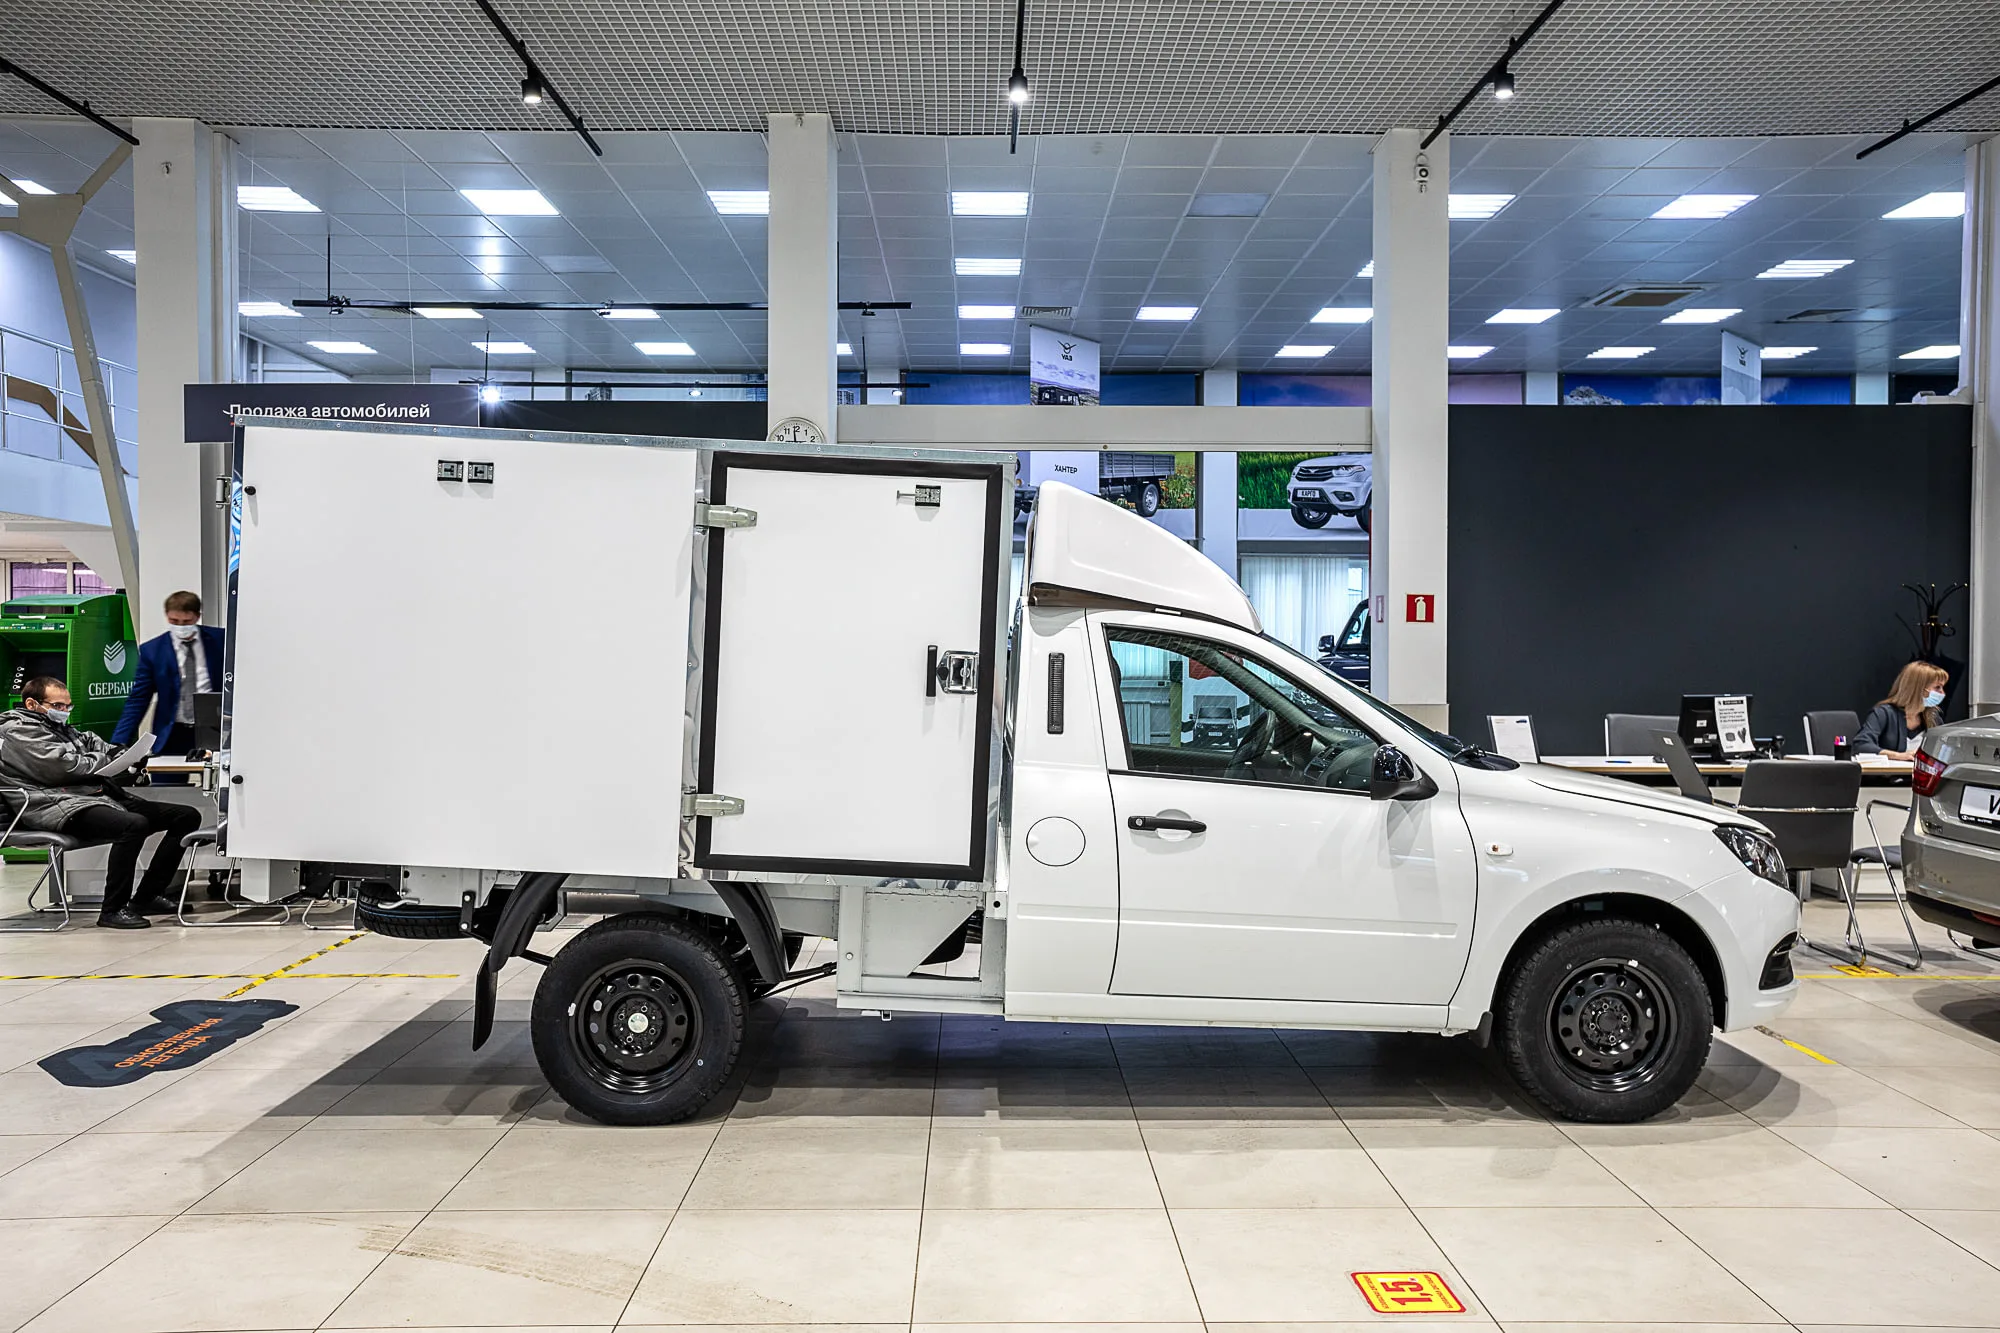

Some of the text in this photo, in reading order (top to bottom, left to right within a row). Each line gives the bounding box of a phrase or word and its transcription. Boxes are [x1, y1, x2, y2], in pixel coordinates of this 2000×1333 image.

[230, 403, 430, 418] Продажа автомобилей
[776, 434, 784, 442] 10
[1054, 464, 1078, 474] ХАНТЕР
[88, 681, 136, 697] СБЕРБАН
[114, 1018, 223, 1068] ОБНОВЛЕННАЯ
[140, 1035, 212, 1068] ЛЕГЕНДА
